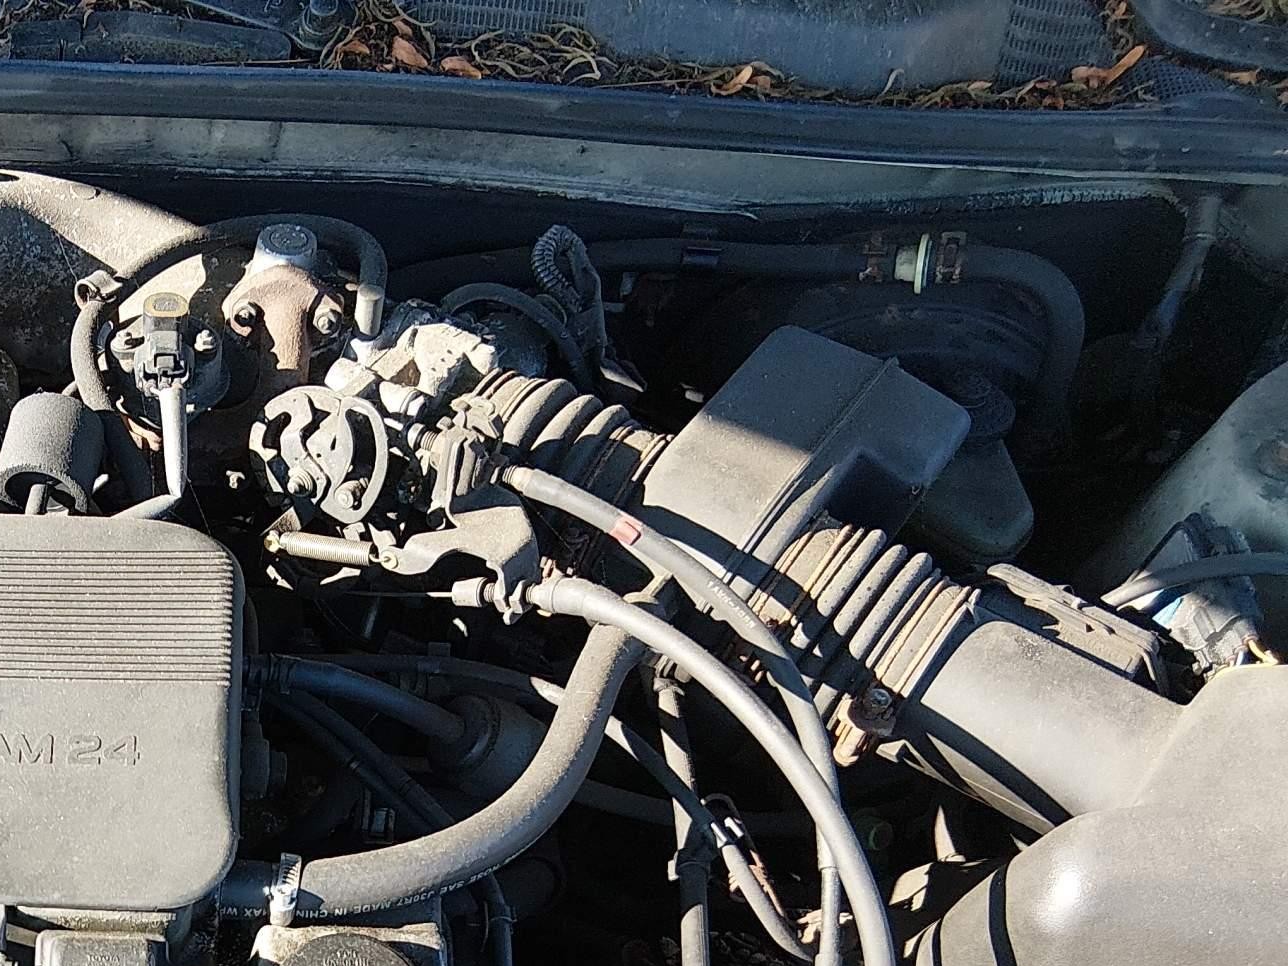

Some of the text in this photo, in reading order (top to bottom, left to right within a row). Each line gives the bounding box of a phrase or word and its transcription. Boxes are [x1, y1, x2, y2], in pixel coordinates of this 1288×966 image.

[66, 733, 142, 768] 24
[440, 878, 464, 894] SAE
[296, 909, 327, 919] CHIN
[334, 906, 347, 916] IN
[354, 899, 391, 914] MADE
